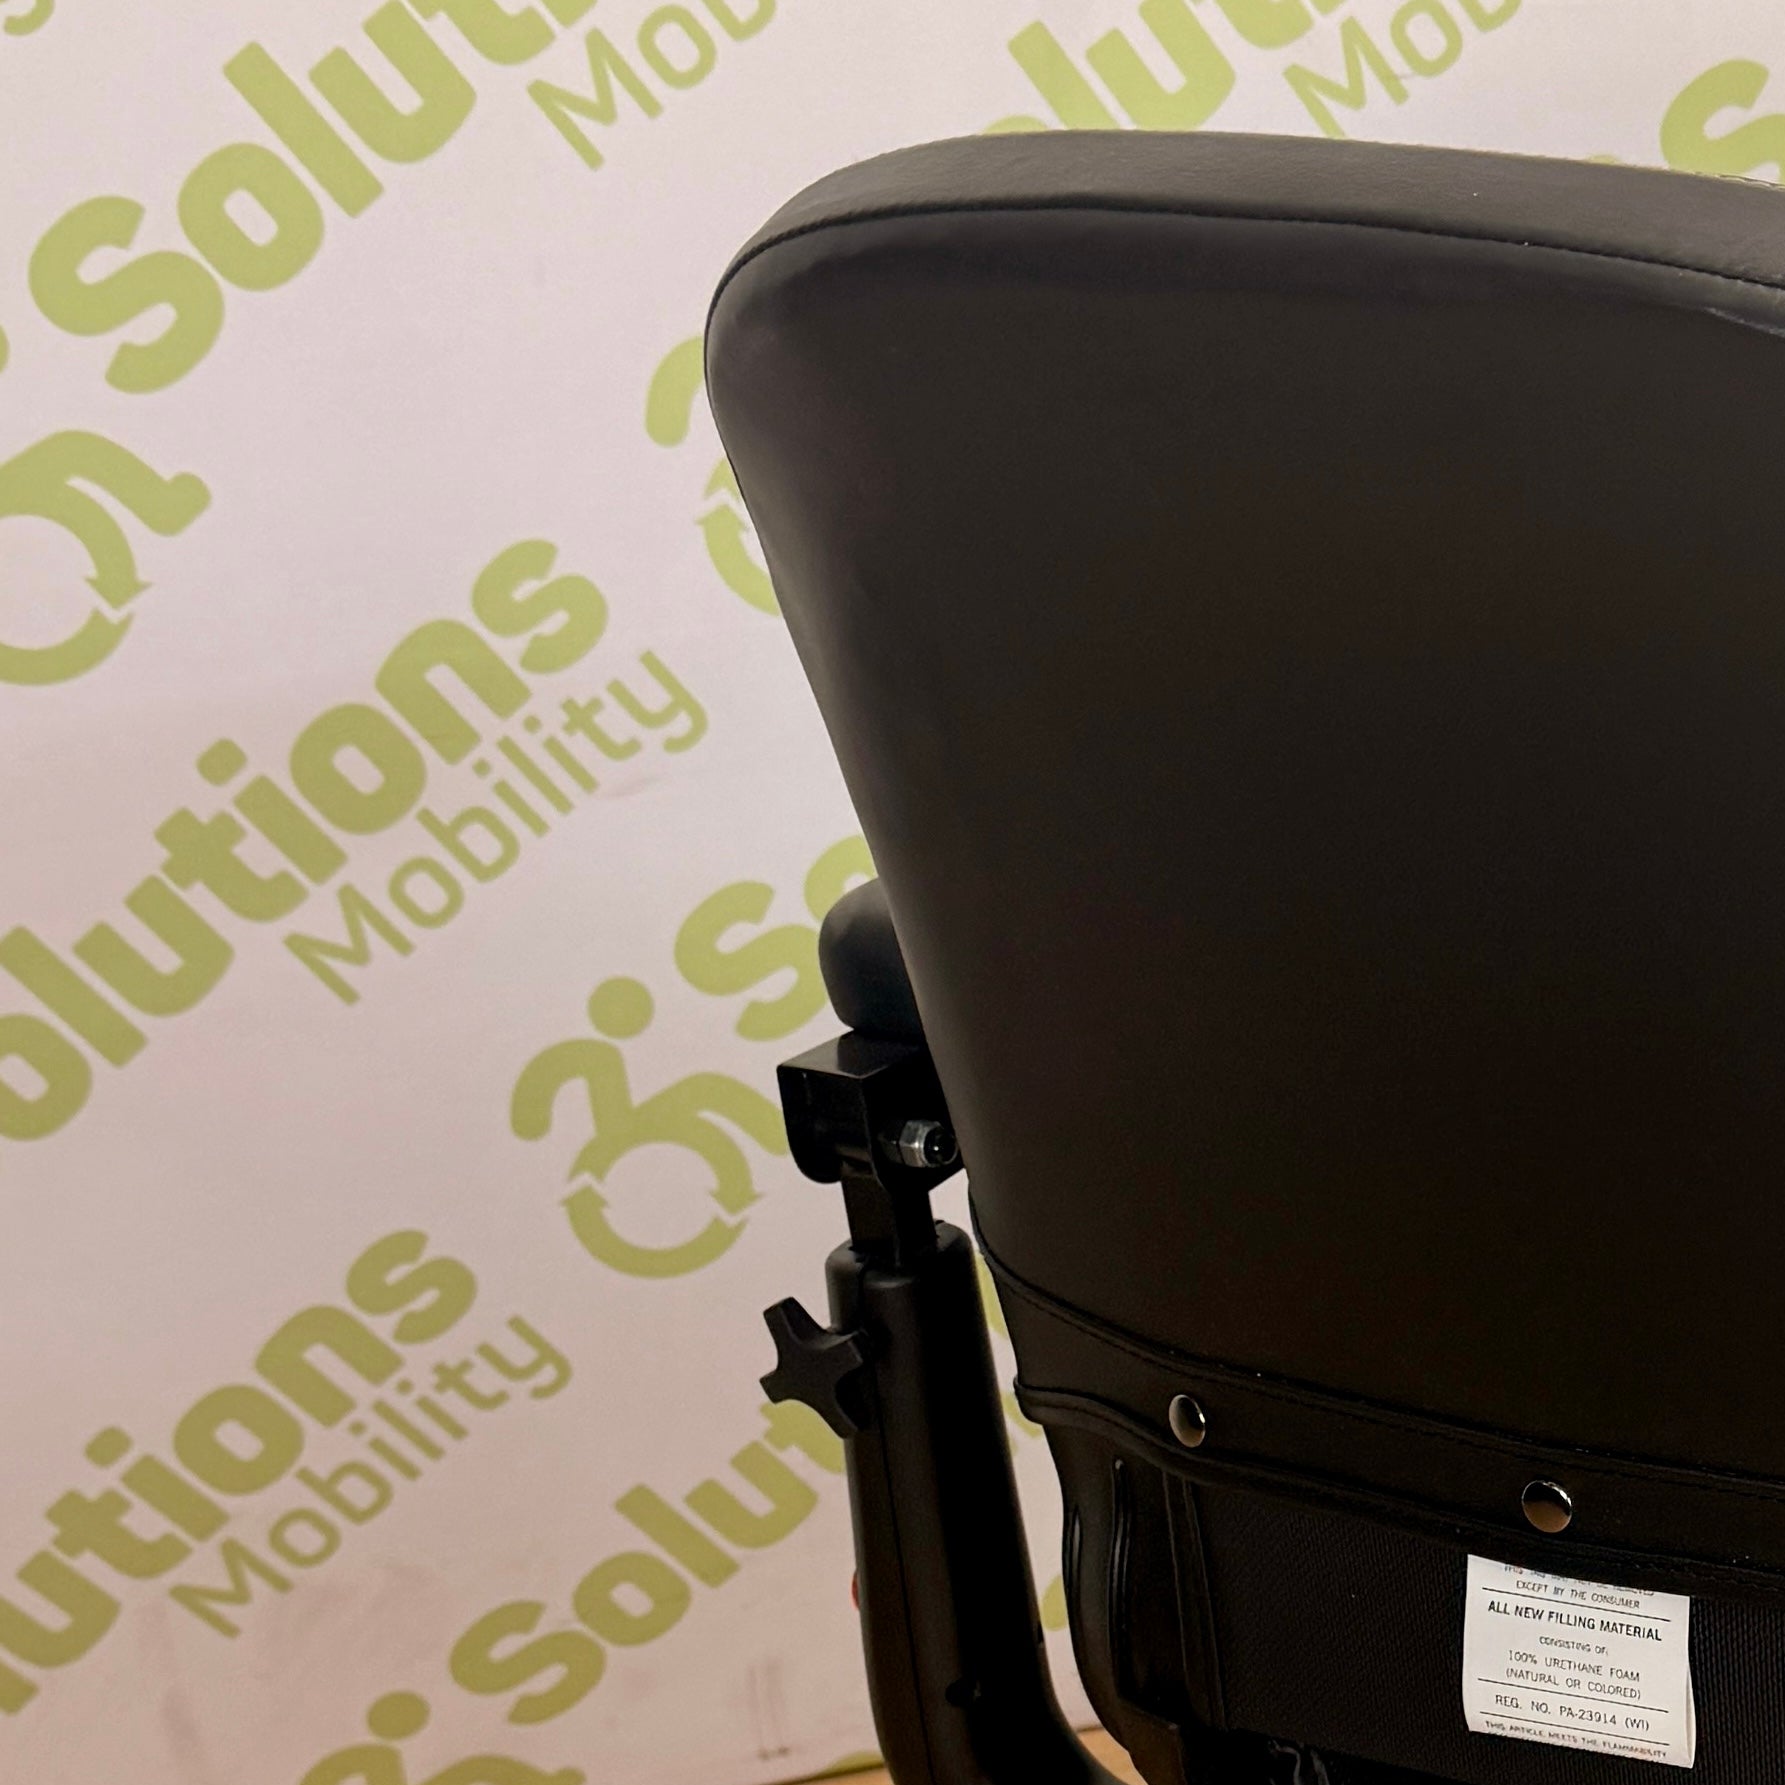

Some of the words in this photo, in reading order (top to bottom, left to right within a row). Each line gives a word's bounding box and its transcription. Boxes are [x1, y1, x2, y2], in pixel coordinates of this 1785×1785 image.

[282, 650, 708, 1006] Mobility
[168, 1314, 573, 1640] Mobility
[1488, 1600, 1510, 1616] ALL
[1515, 1605, 1543, 1621] NEW
[1547, 1610, 1595, 1630] FILLING
[1600, 1620, 1662, 1642] MATERIAL
[1506, 1667, 1559, 1686] (NATURAL
[1566, 1678, 1581, 1690] OR
[1588, 1681, 1641, 1699] COLORED)
[1509, 1650, 1538, 1665] 100%
[1545, 1657, 1603, 1676] URETHANE
[1610, 1668, 1640, 1682] FOAM
[1495, 1694, 1522, 1710] REG.
[1531, 1701, 1551, 1715] NO.
